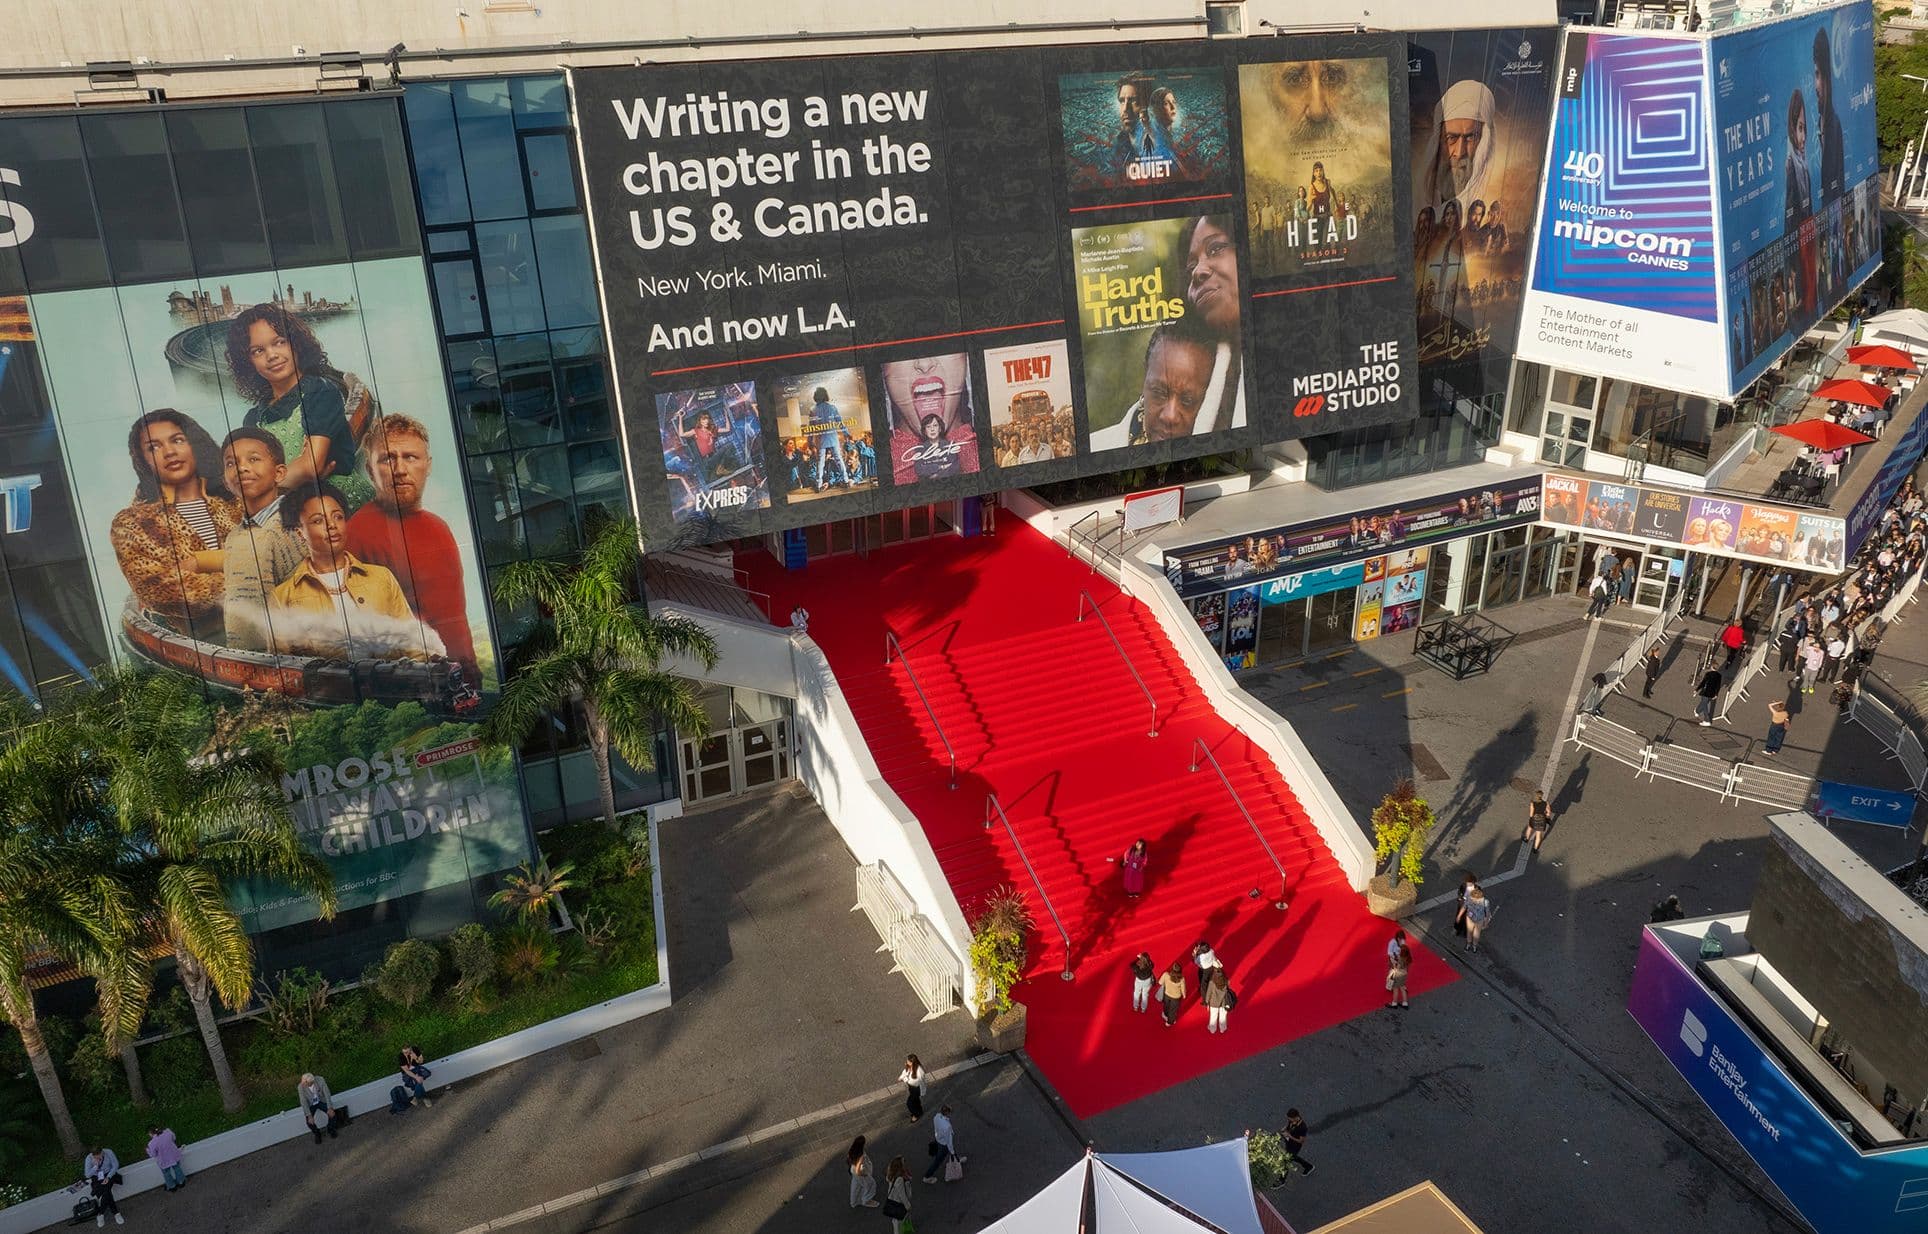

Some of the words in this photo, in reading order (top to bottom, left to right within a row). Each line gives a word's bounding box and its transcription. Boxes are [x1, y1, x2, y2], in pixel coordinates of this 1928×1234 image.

[1567, 68, 1578, 92] mip
[612, 92, 790, 140] Writing
[804, 96, 830, 127] a
[842, 90, 928, 125] new
[1724, 123, 1744, 154] THE
[1746, 112, 1770, 144] NEW
[622, 150, 799, 197] chapter
[812, 139, 852, 180] in
[863, 135, 931, 175] the
[1127, 160, 1172, 180] QUIET
[1563, 150, 1604, 178] 40
[1726, 148, 1772, 192] YEARS
[1562, 175, 1601, 186] anniversary
[629, 205, 697, 250] US
[709, 202, 743, 243] &
[754, 187, 929, 238] Canada.
[1558, 198, 1616, 218] Welcome
[1619, 208, 1633, 220] to
[1287, 214, 1358, 247] HEAD
[1554, 219, 1692, 257] mipcom
[1300, 248, 1337, 259] SEASON
[1628, 252, 1688, 271] CANNES
[638, 274, 689, 298] New
[695, 266, 752, 291] York.
[757, 258, 827, 284] Miami.
[1082, 266, 1162, 302] Hard
[1085, 294, 1184, 328] Truths
[1543, 305, 1564, 318] The
[1566, 310, 1607, 326] Mother
[1609, 319, 1622, 330] of
[1624, 322, 1638, 333] all
[647, 317, 713, 353] And
[722, 313, 788, 343] now
[798, 302, 856, 334] L.A.
[1540, 318, 1620, 343] Entertainment
[1360, 340, 1398, 364] THE
[1538, 330, 1584, 350] Content
[1586, 340, 1632, 359] Markets
[1003, 358, 1032, 384] THE
[1032, 355, 1051, 378] 47
[1292, 362, 1400, 397] MEDIAPRO
[1328, 383, 1400, 412] STUDIO
[901, 440, 971, 462] Celeste
[695, 485, 748, 512] EXPRESS
[1546, 479, 1580, 493] JACKAL
[1650, 492, 1660, 500] OUR
[1660, 493, 1680, 503] STORIES
[1644, 499, 1654, 507] ARE
[1655, 501, 1681, 512] UNIVERSAL
[1702, 501, 1731, 519] Hacks
[1852, 484, 1880, 536] mipcom
[1410, 516, 1448, 532] DOCUMENTARIES
[1641, 528, 1673, 538] UNIVERSAL
[1801, 516, 1830, 528] SUITS
[1831, 520, 1844, 529] LA
[1298, 540, 1338, 555] ENTERTAINMENT
[1194, 566, 1215, 576] DRAMA
[1268, 574, 1303, 596] AMUZ
[426, 742, 473, 762] PRIMROSE
[280, 746, 411, 802] MROSE
[1851, 796, 1881, 808] EXIT
[321, 792, 491, 857] CHILDREN
[260, 901, 278, 912] Kids
[288, 894, 315, 906] Family
[366, 876, 377, 886] for
[379, 872, 397, 881] BBC
[1712, 1044, 1748, 1088] Banijay
[1708, 1056, 1781, 1142] Entertainment
